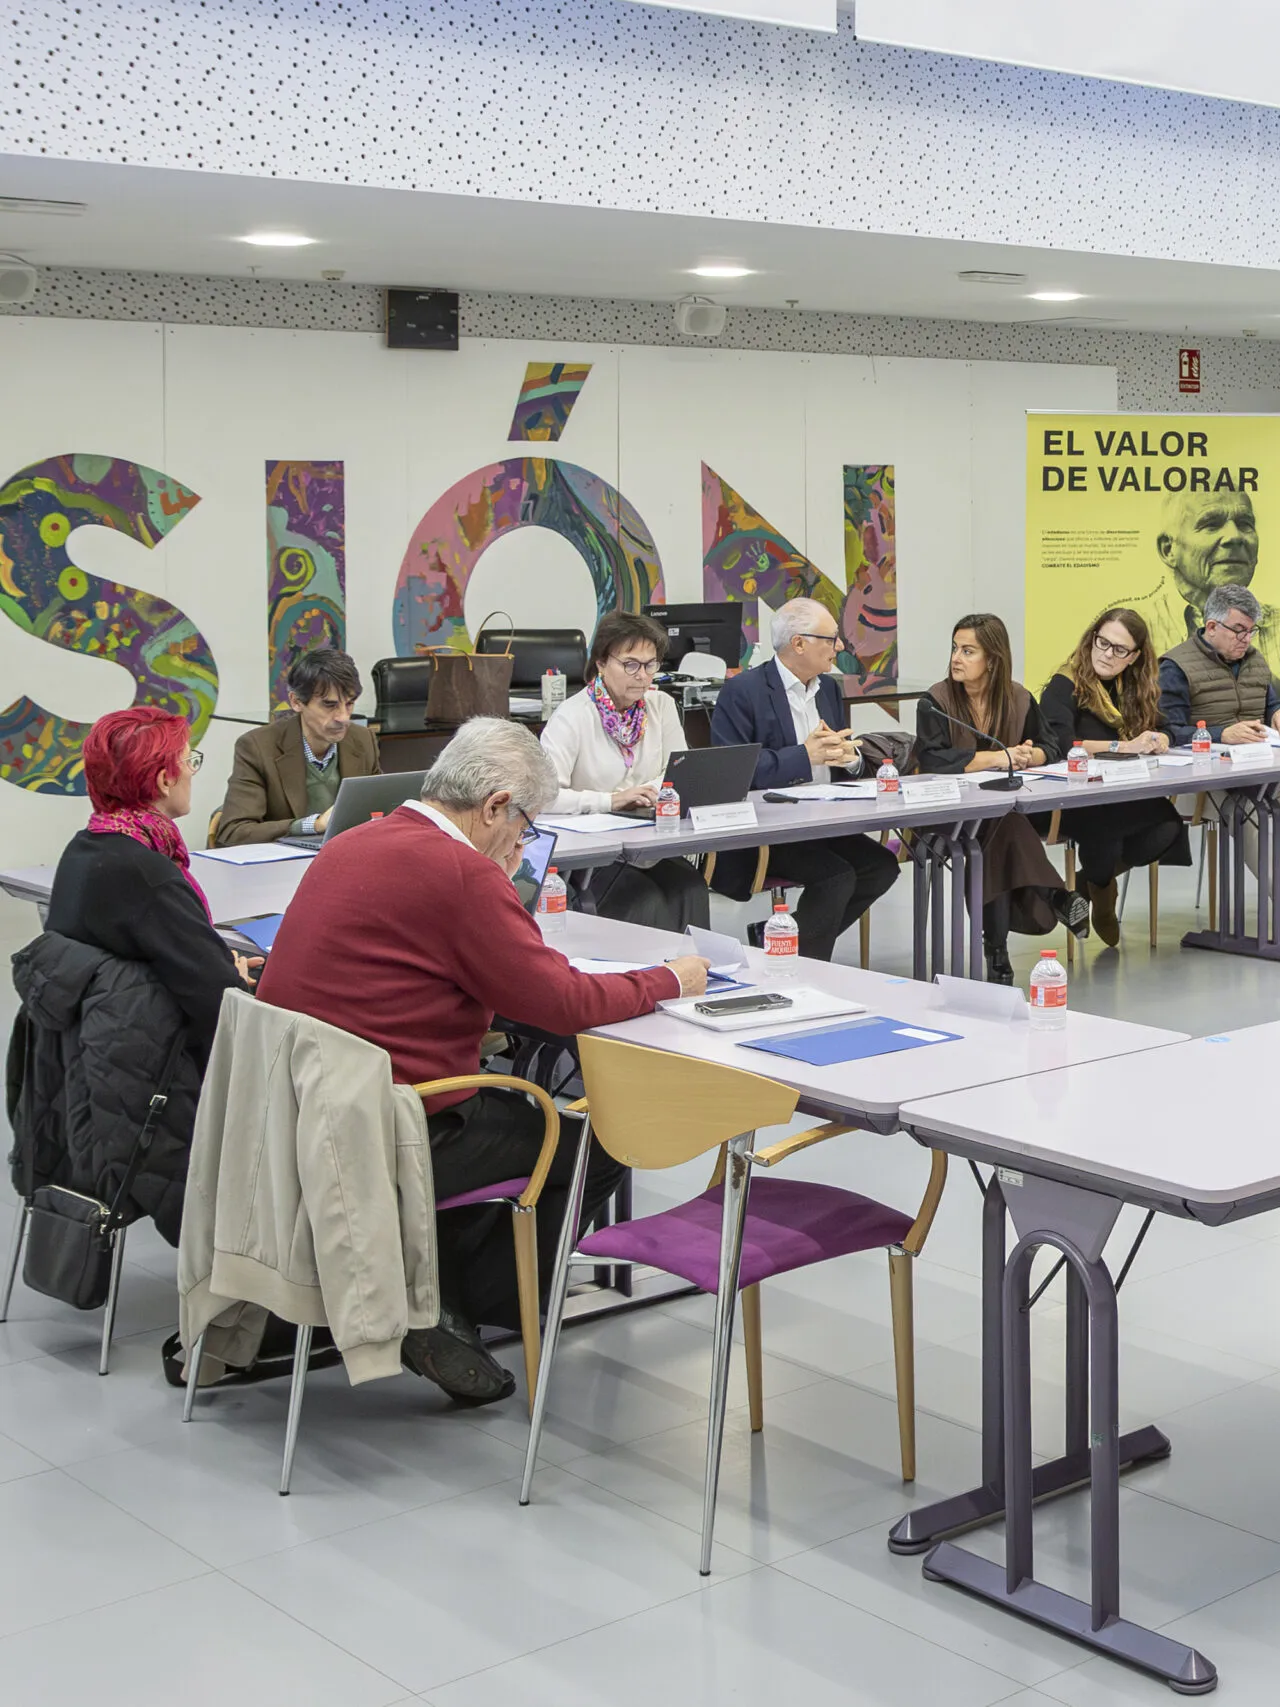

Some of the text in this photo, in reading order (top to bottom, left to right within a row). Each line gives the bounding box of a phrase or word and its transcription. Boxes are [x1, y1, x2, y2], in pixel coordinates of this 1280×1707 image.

[1044, 430, 1208, 457] EL VALOR
[1042, 466, 1259, 492] DE VALORAR
